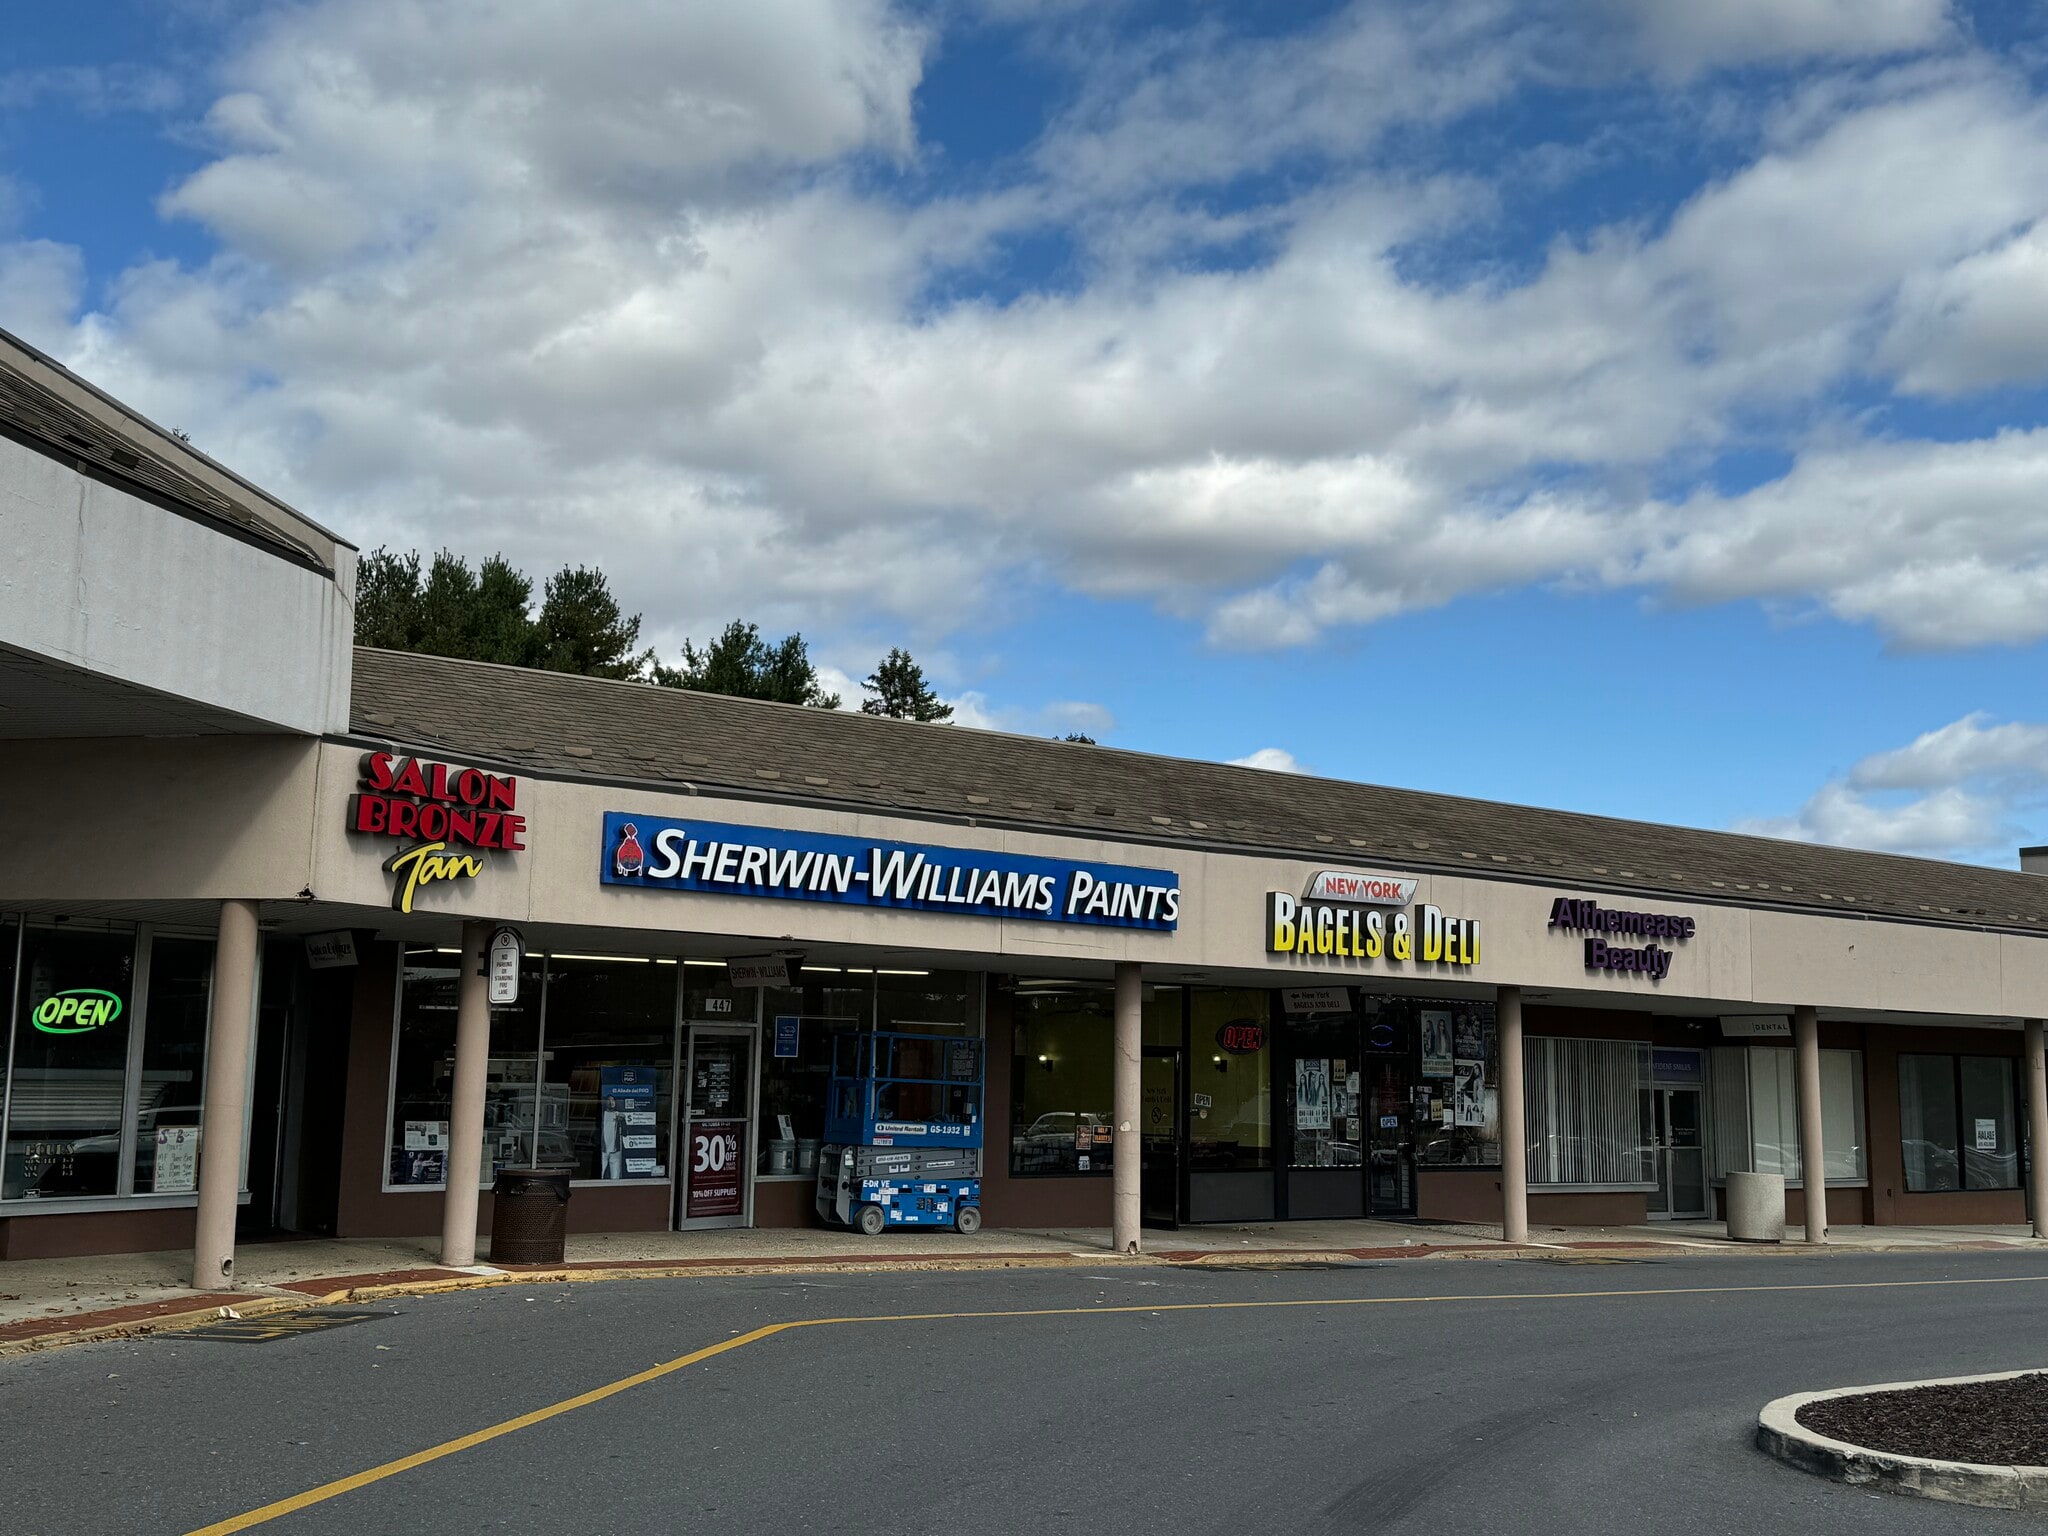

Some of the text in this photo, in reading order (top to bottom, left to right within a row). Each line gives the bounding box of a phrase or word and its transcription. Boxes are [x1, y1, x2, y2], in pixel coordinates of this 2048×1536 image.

[367, 751, 516, 811] SALON
[357, 793, 527, 851] BRONZE
[391, 841, 483, 914] Tan
[648, 828, 1181, 922] SHERWIN-WILLIAMS PAINTS
[1325, 877, 1402, 900] NEW YORK
[1273, 891, 1480, 965] BAGELS & DELI
[1554, 898, 1696, 938] Althemease
[1591, 938, 1674, 980] Beauty
[731, 966, 786, 979] SHERWIN-WILLIAMS
[38, 996, 114, 1026] OPEN
[712, 1000, 731, 1012] 447
[1223, 1025, 1263, 1050] OPEN
[1755, 1023, 1789, 1031] DENTAL
[1195, 1094, 1210, 1106] OPEN
[930, 1125, 961, 1134] GS-1932
[725, 1152, 737, 1161] OFF
[714, 1187, 737, 1196] SUPPLIES
